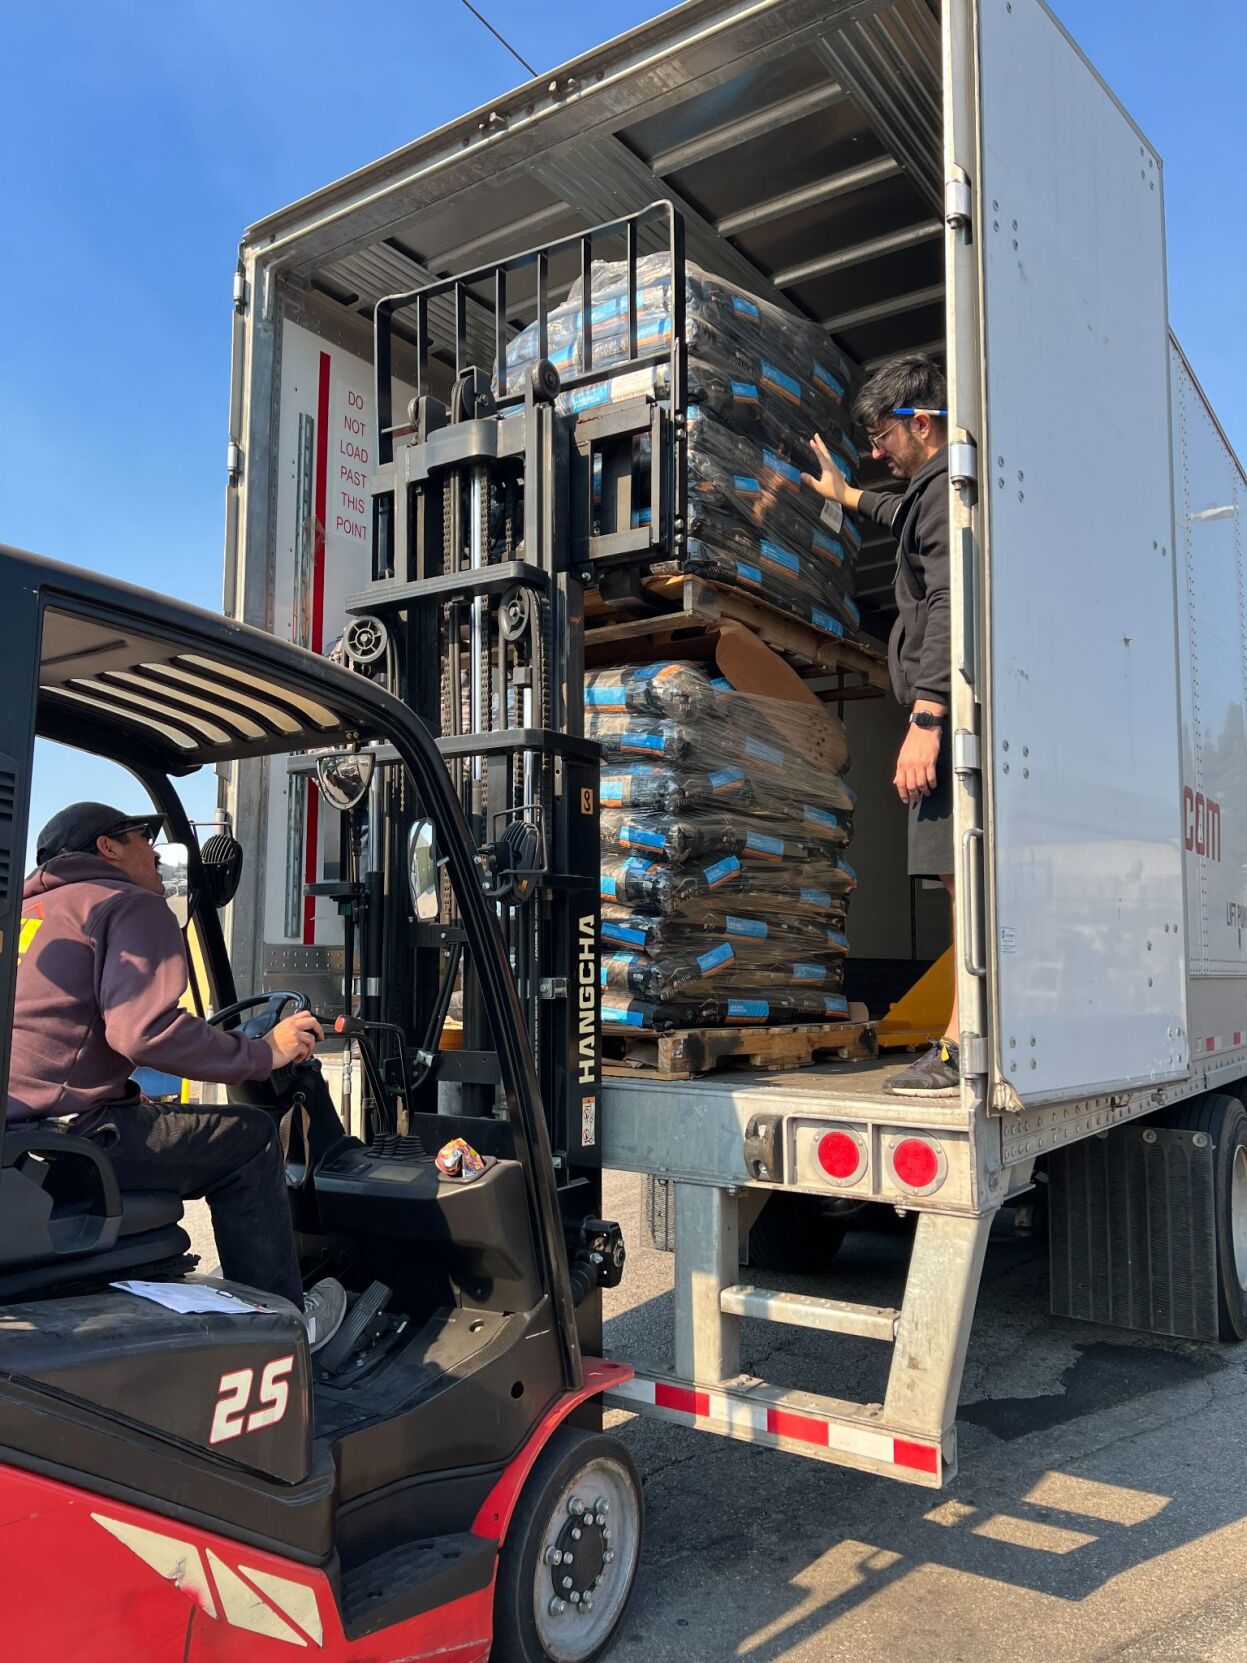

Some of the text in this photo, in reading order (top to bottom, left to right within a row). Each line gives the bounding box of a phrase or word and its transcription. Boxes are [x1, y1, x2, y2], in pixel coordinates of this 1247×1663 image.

[348, 391, 364, 410] DO
[344, 415, 367, 437] NOT
[340, 439, 369, 463] LOAD
[340, 465, 367, 489] PAST
[341, 491, 365, 514] THIS
[336, 516, 367, 540] POINT
[578, 914, 595, 1084] HANGCHA
[208, 1354, 295, 1445] 25
